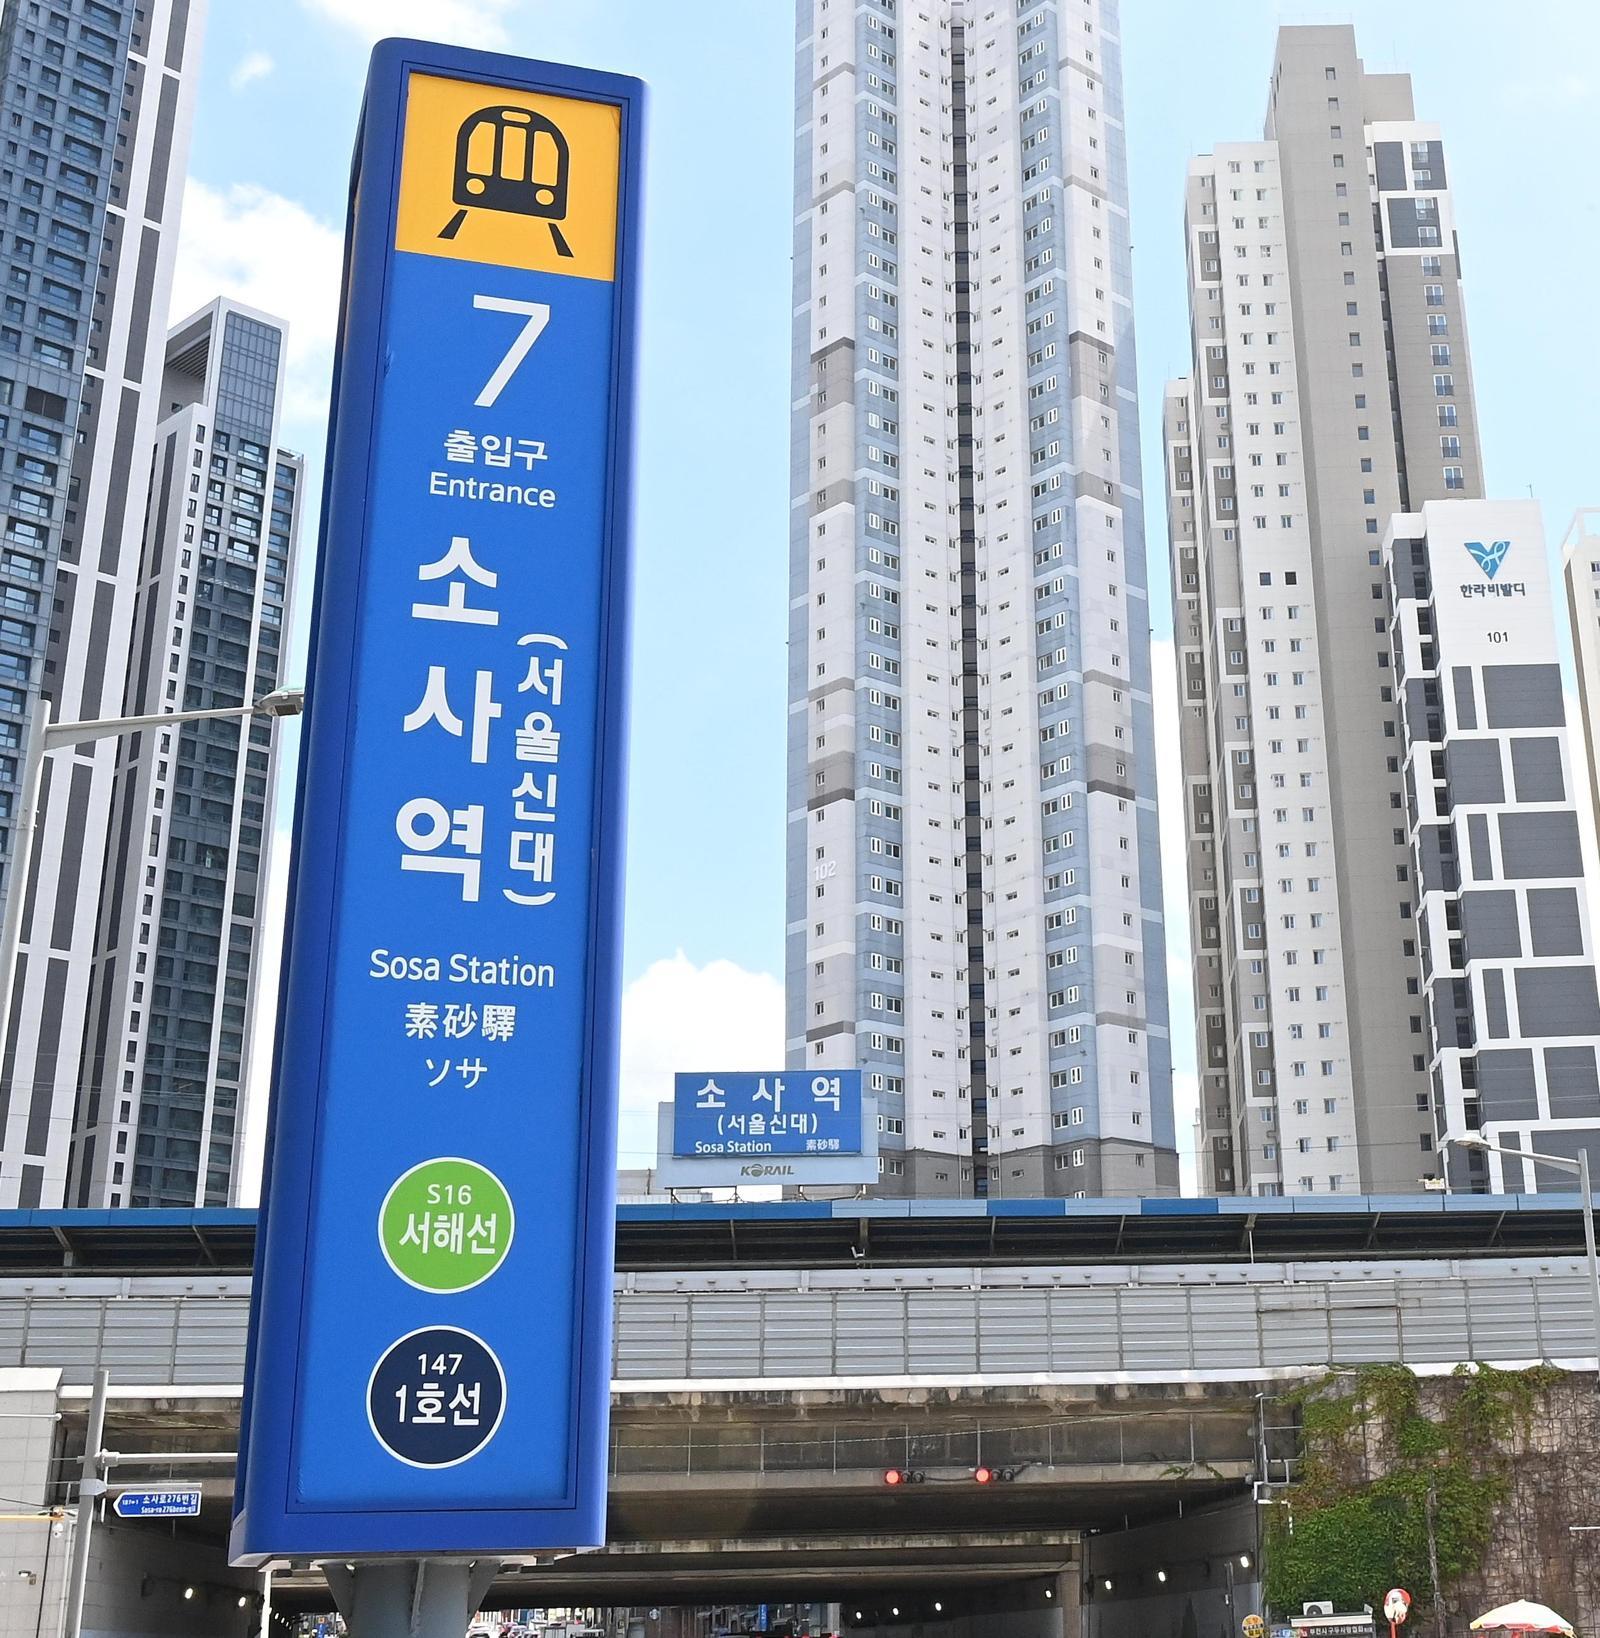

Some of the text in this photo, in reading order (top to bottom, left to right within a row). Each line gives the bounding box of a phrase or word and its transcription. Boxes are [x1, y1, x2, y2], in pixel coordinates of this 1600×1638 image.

[473, 294, 550, 407] 7
[443, 429, 548, 471] 출입구
[429, 471, 556, 508] Entrance
[1487, 632, 1509, 643] 101
[394, 536, 502, 902] 소사역
[502, 633, 568, 906] (서울신대)
[813, 860, 837, 880] 102
[369, 948, 555, 987] Sosa Station
[405, 1002, 516, 1042] 素砂驛
[425, 1057, 488, 1089] ソサ
[717, 1112, 818, 1136] (서울신대)
[695, 1140, 772, 1153] Sosa Station
[741, 1163, 795, 1177] KORAIL
[427, 1184, 472, 1205] S16
[399, 1211, 497, 1255] 서해선
[418, 1353, 463, 1376] 147
[395, 1382, 481, 1426] 1호선
